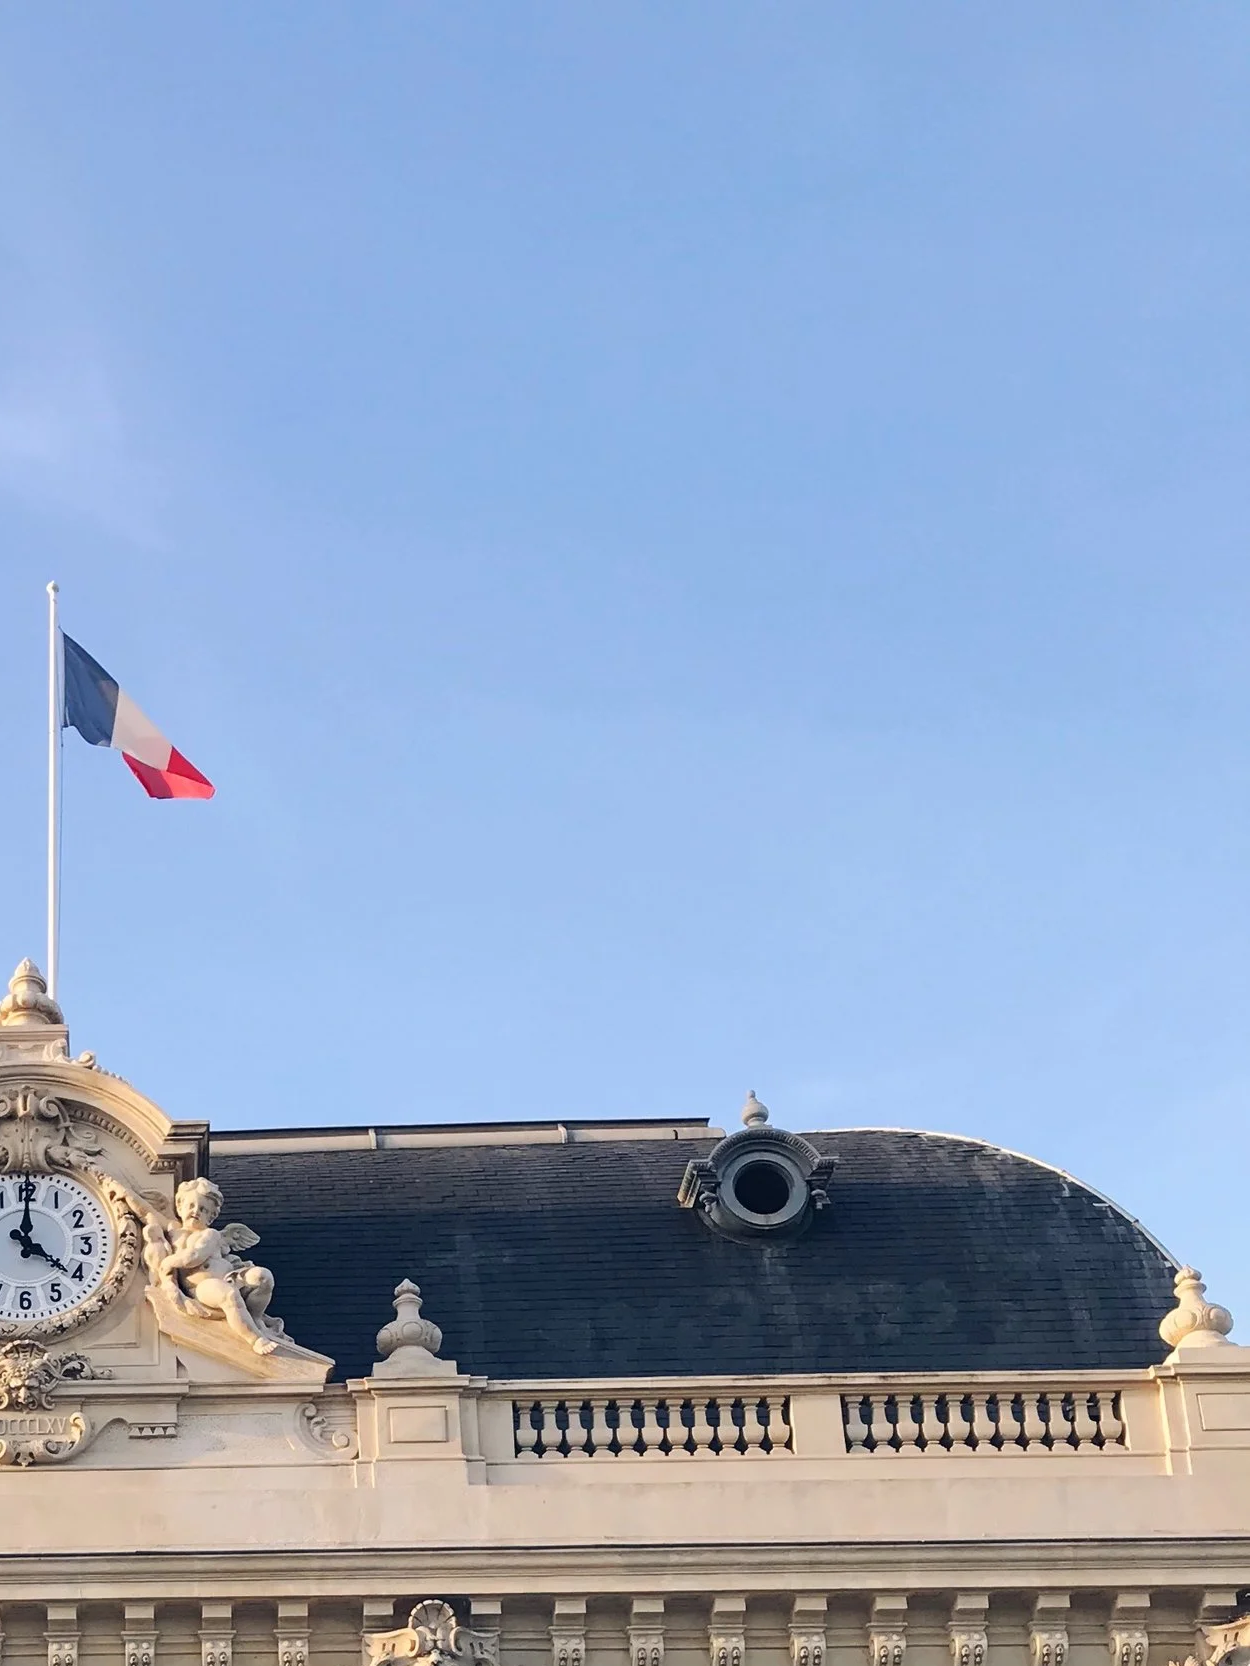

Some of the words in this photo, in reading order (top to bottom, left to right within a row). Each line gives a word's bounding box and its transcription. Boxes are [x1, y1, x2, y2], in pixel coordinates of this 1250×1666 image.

[19, 1183, 36, 1202] 12
[54, 1191, 59, 1209] 1
[72, 1210, 84, 1228] 2
[80, 1237, 92, 1255] 3
[71, 1263, 83, 1281] 4
[19, 1291, 32, 1310] 6
[50, 1283, 62, 1302] 5
